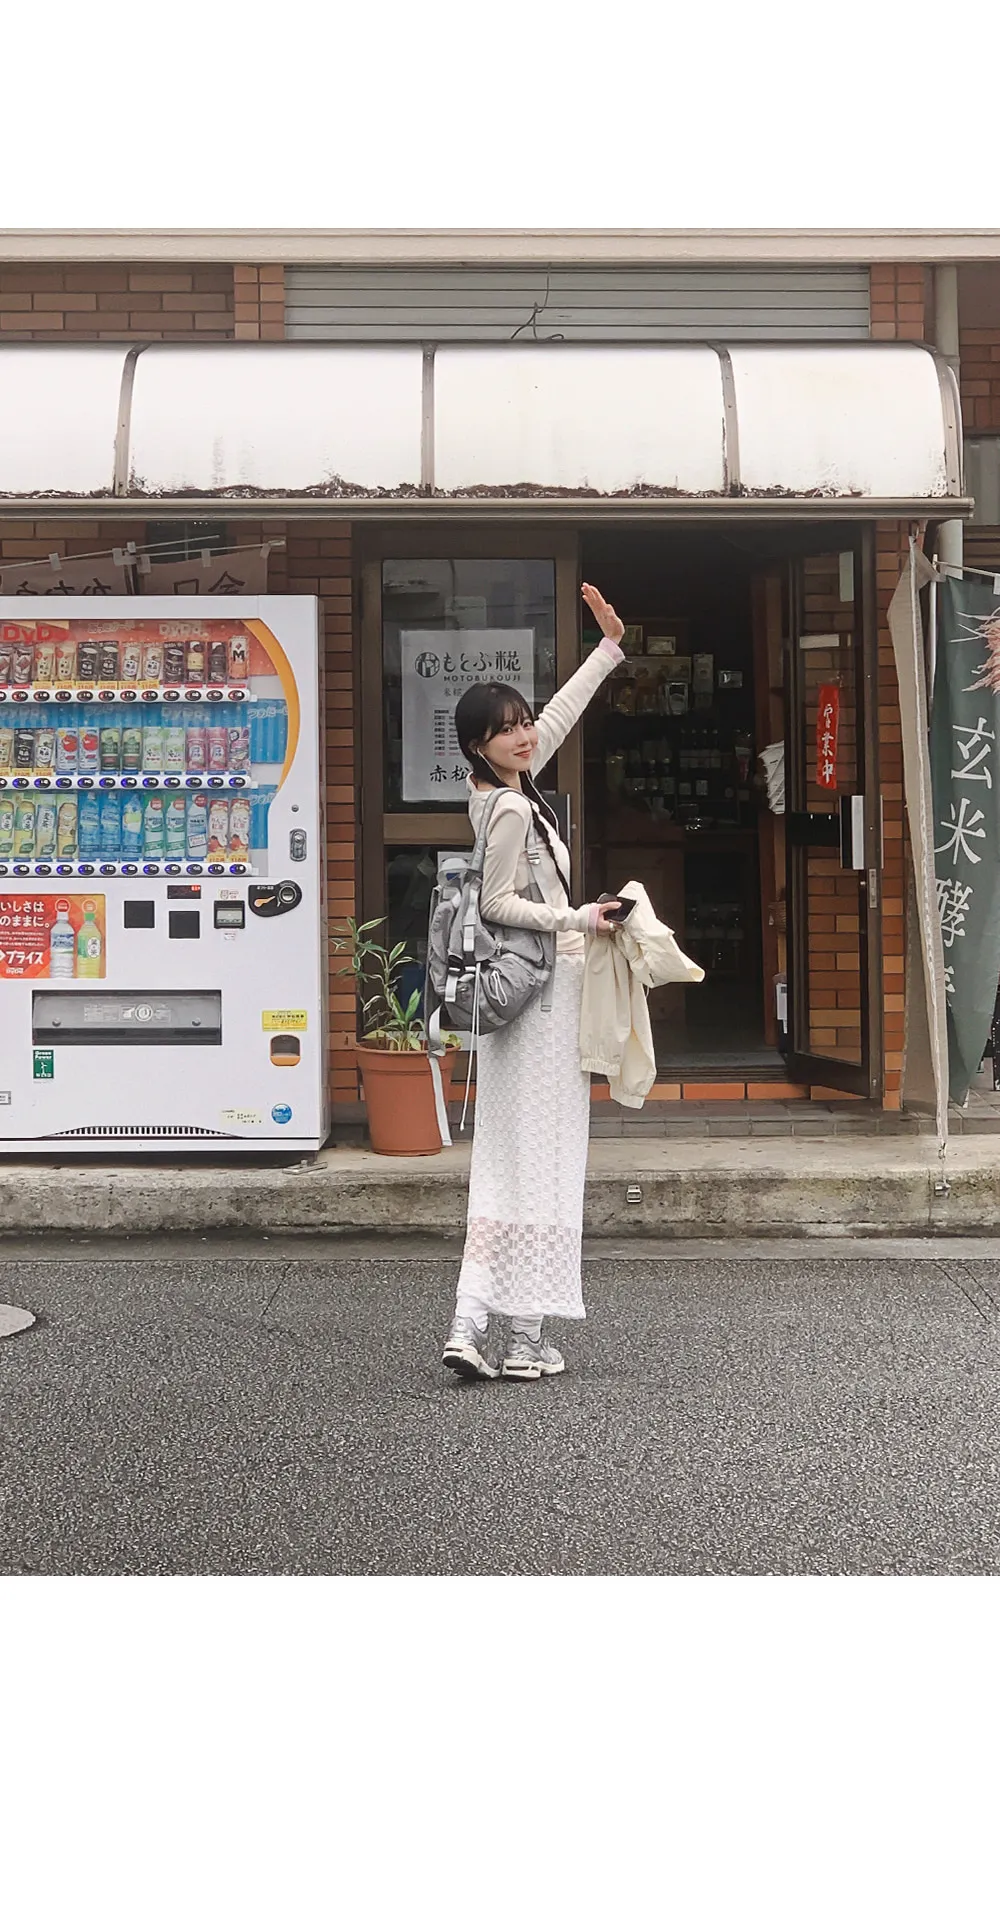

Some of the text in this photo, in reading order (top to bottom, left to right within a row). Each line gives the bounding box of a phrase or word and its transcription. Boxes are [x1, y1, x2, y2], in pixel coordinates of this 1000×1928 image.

[232, 649, 246, 662] M
[443, 650, 522, 673] もとぶ糀
[443, 674, 521, 682] MOTOBUKOUJI
[821, 702, 836, 785] 営業中
[0, 901, 45, 912] いしさは
[0, 915, 50, 929] のままに。
[6, 950, 44, 965] プライス
